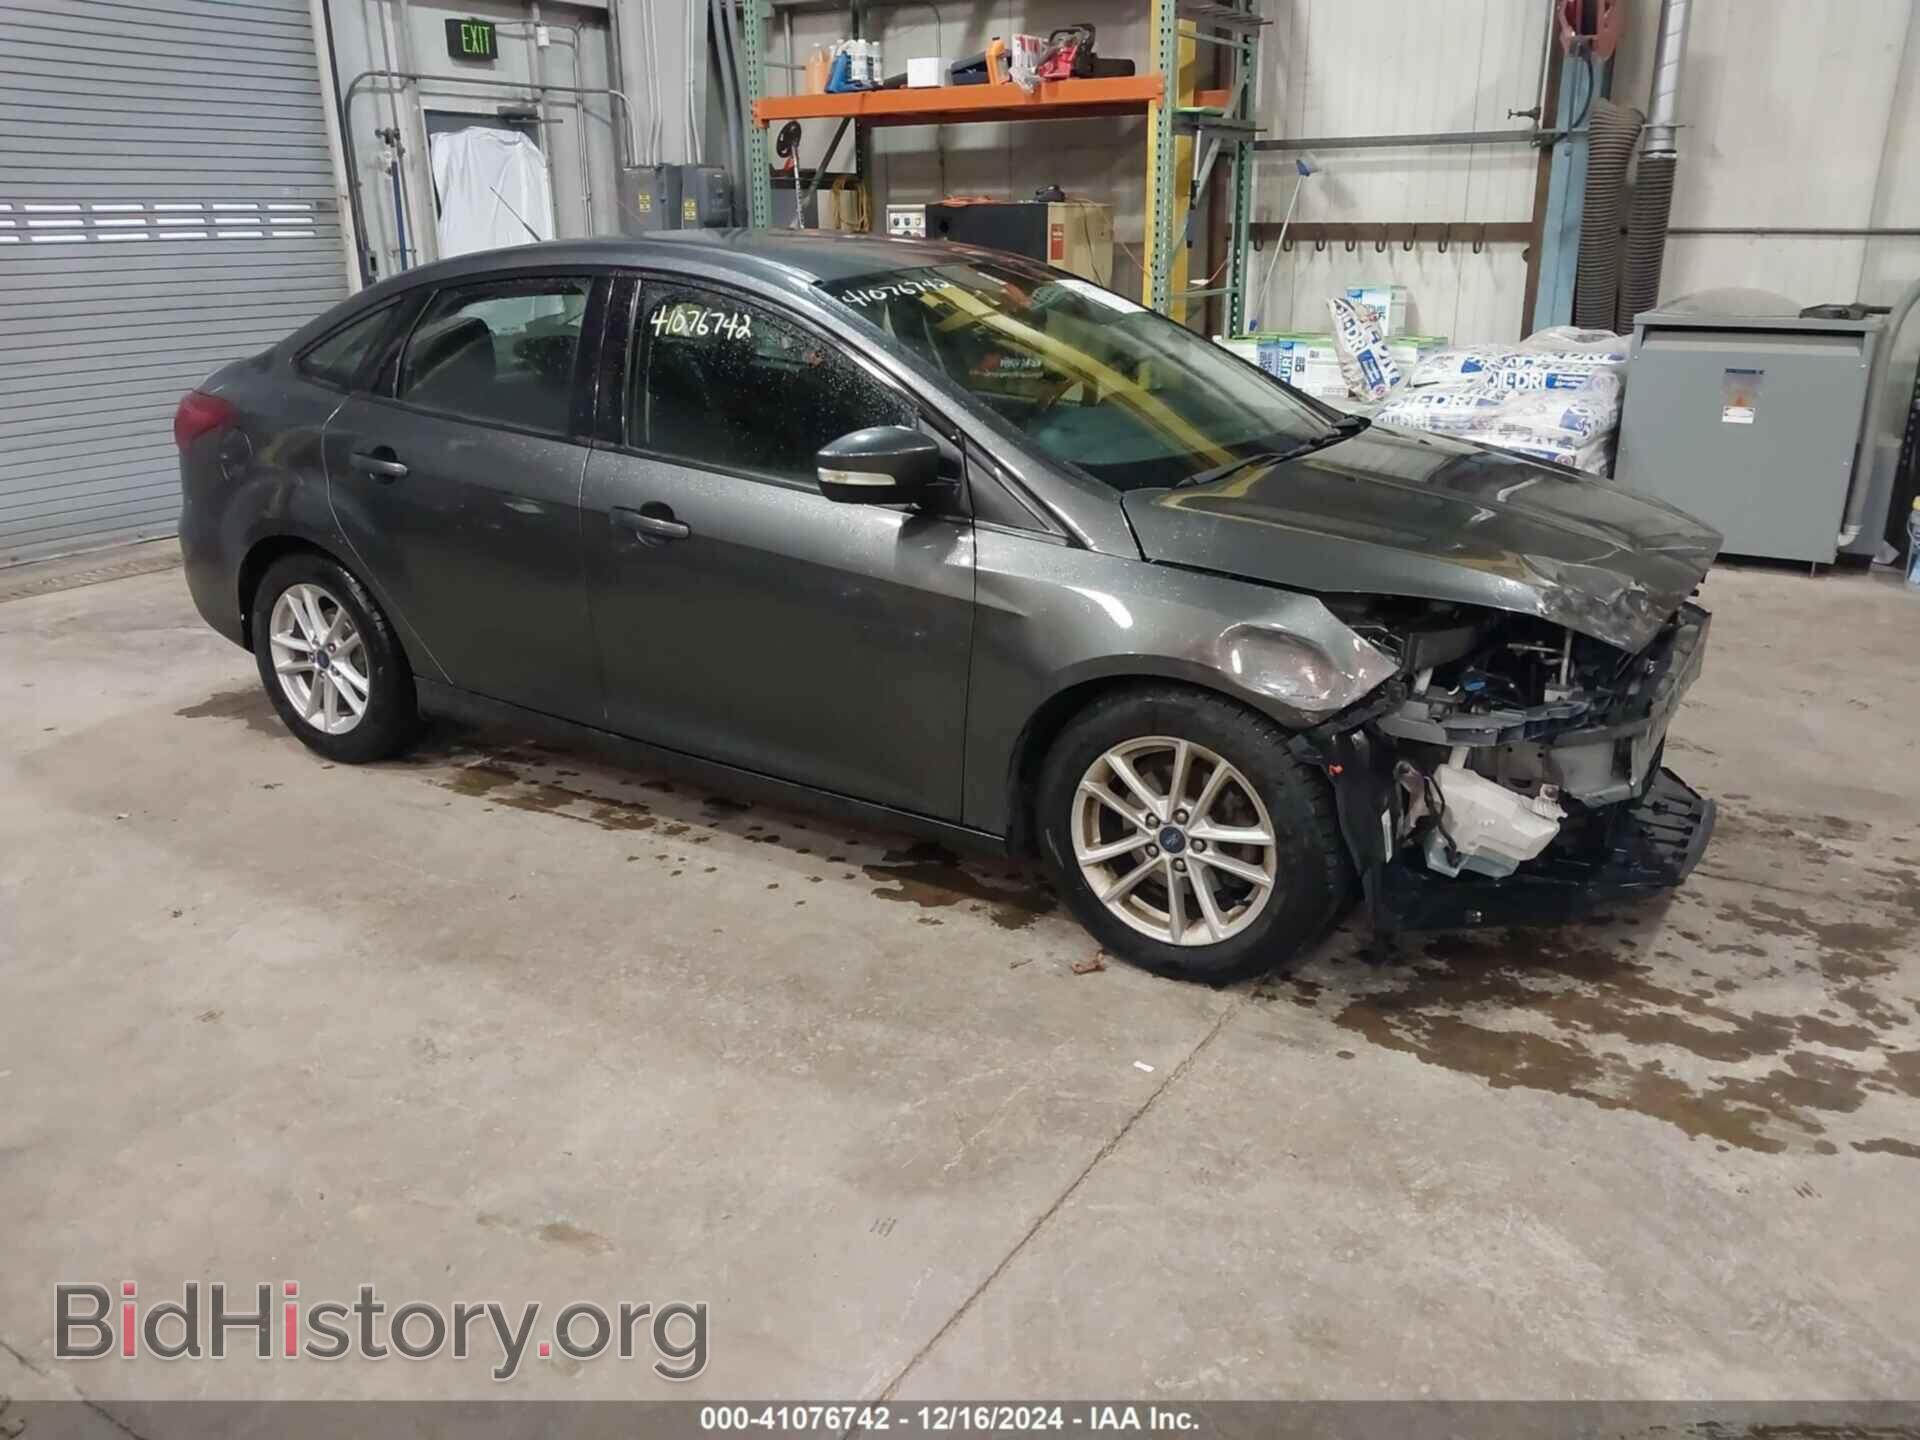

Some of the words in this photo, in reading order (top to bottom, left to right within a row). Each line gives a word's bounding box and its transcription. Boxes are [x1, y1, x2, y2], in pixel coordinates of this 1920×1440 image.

[461, 24, 490, 54] EXIT
[842, 279, 957, 307] 41076742
[650, 305, 751, 340] 41076742
